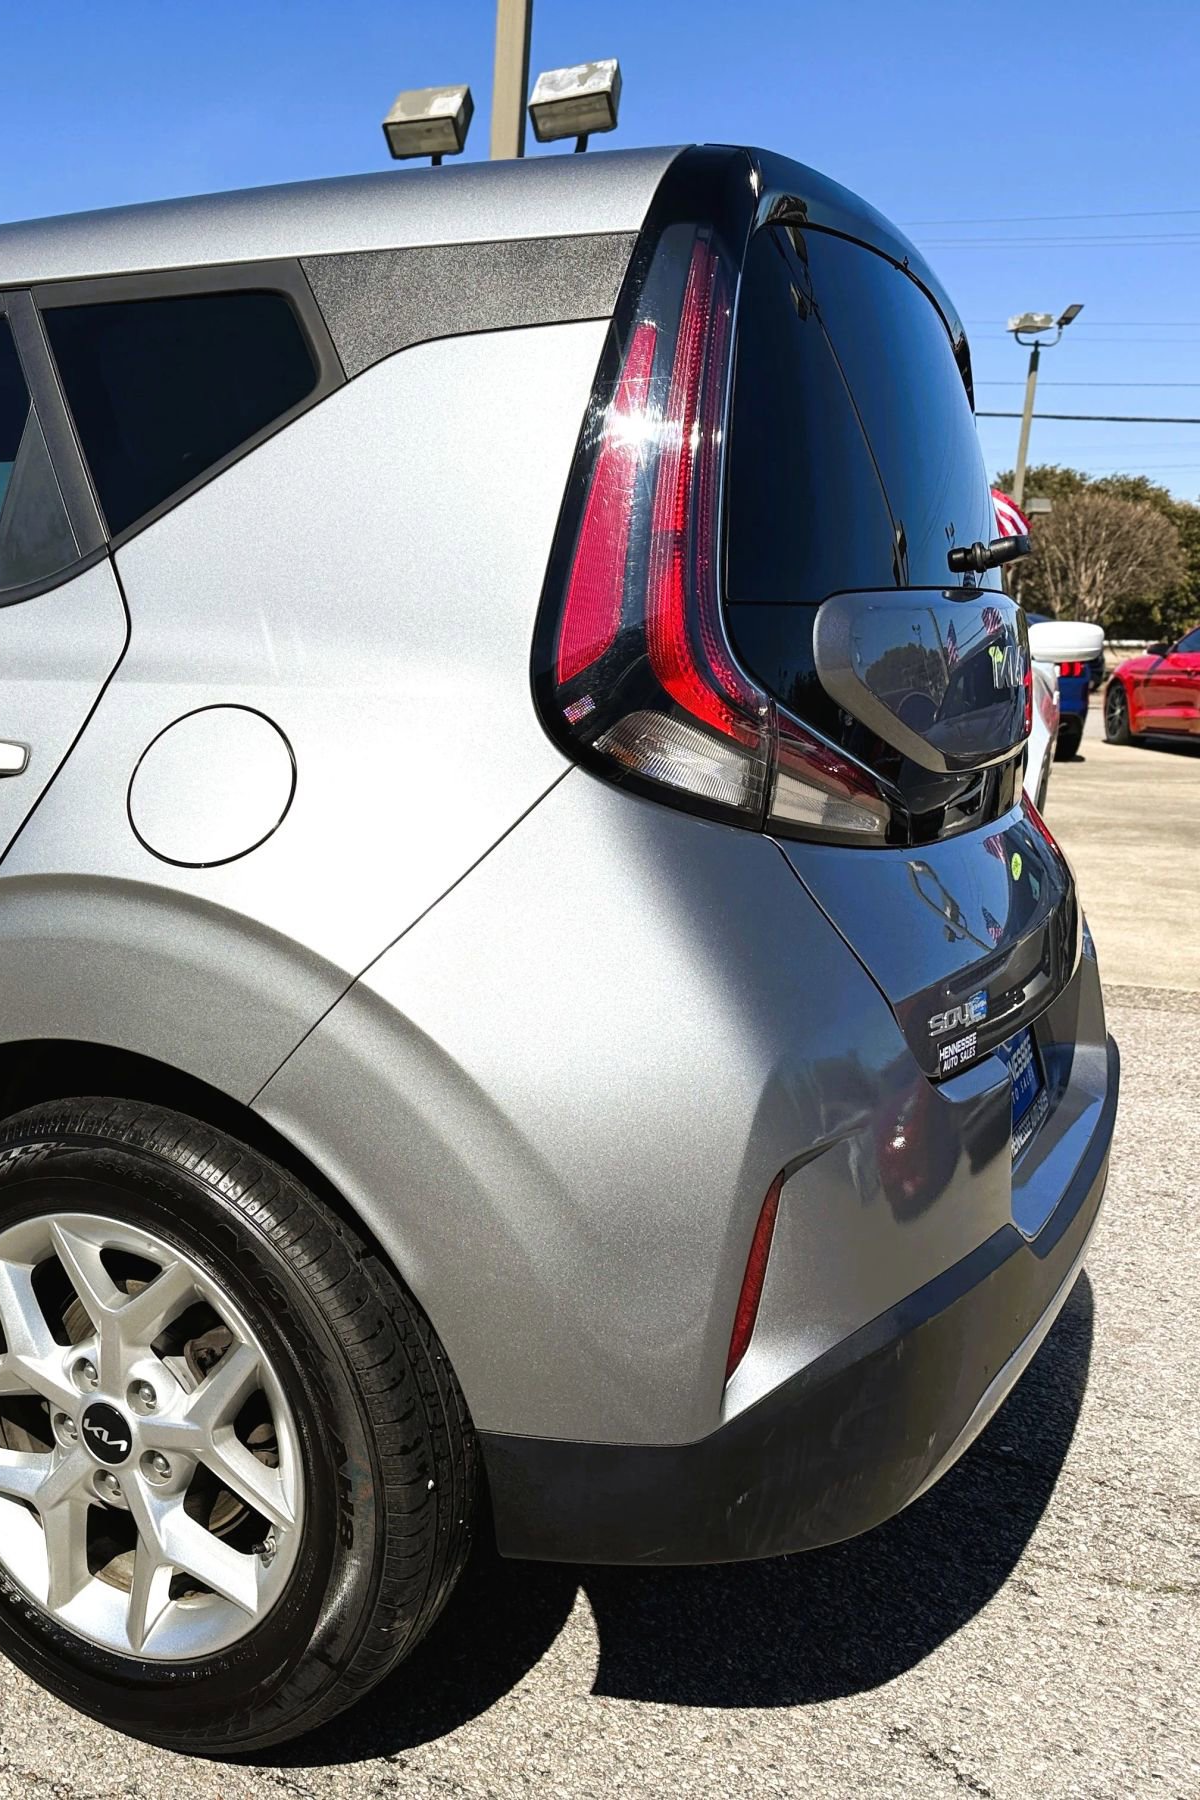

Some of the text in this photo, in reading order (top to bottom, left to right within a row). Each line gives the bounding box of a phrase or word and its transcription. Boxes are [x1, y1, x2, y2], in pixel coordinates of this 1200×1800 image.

[939, 1031, 977, 1062] HENNESSEE
[942, 1045, 976, 1073] AUTO SALES
[1007, 1034, 1033, 1082] NESSEE
